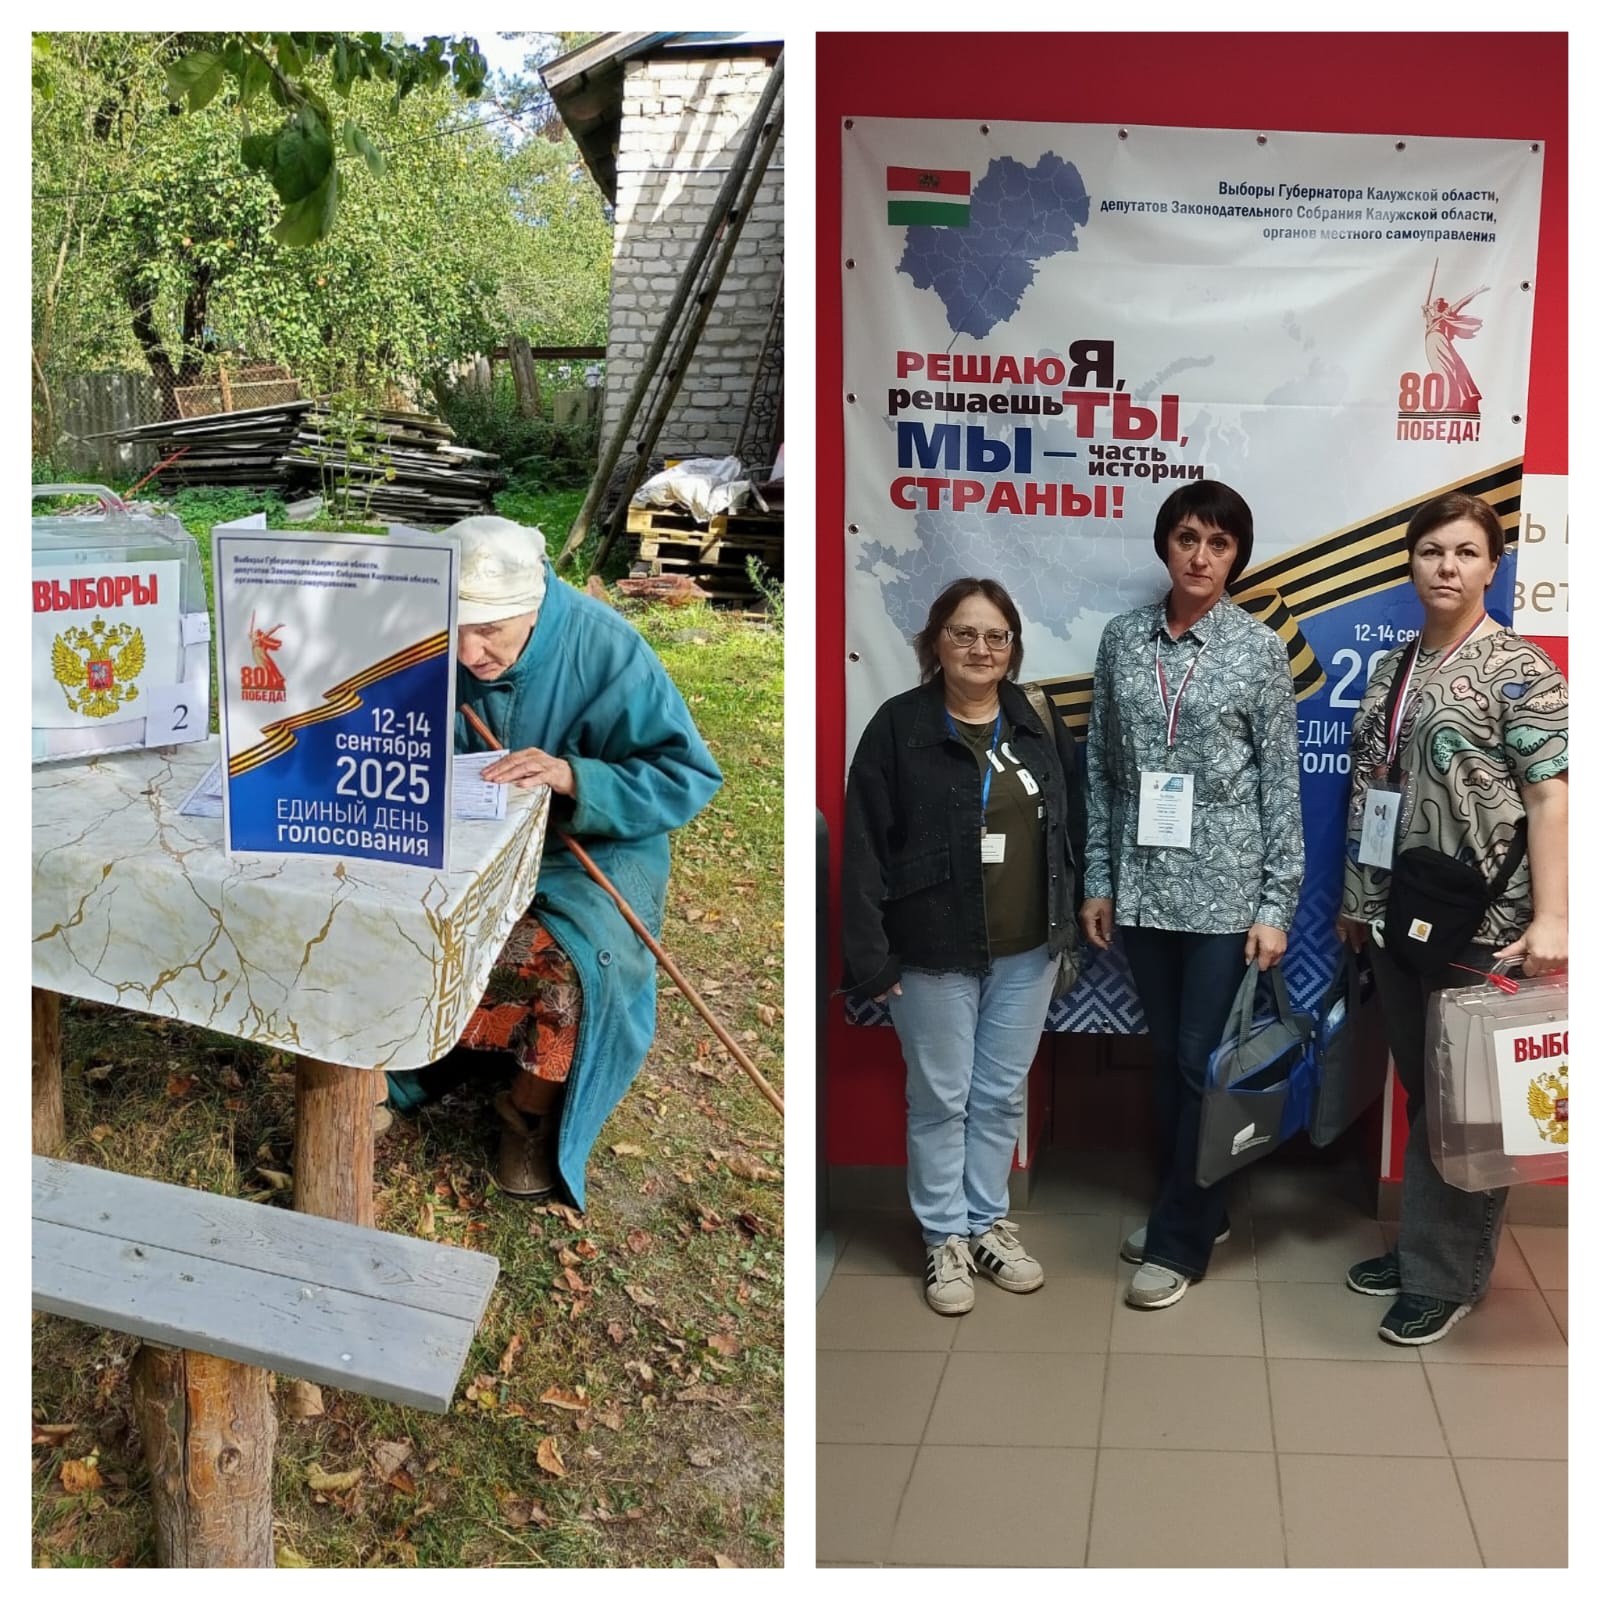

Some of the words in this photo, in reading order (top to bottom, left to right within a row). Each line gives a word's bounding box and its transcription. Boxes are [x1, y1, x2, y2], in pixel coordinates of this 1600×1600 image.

[1218, 181, 1275, 199] Выборы
[1278, 184, 1363, 202] Губернатора
[1366, 187, 1438, 203] Калужской
[1441, 188, 1499, 204] области,
[1100, 199, 1168, 214] депутатов
[1171, 200, 1293, 218] Законодательного
[1296, 205, 1362, 222] Собрания
[1366, 207, 1438, 223] Калужской
[1441, 207, 1497, 224] области,
[1263, 227, 1317, 241] органов
[1319, 229, 1382, 240] местного
[1385, 229, 1496, 243] самоуправления
[896, 350, 1066, 386] РЕШАЮ
[1067, 339, 1126, 393] Я,
[1398, 371, 1446, 412] 80
[888, 388, 1064, 416] решаешь
[1062, 390, 1189, 448] ТЫ,
[1396, 420, 1481, 445] ПОБЕДА!
[896, 421, 1032, 474] МЫ
[1088, 444, 1167, 462] часть
[1088, 460, 1205, 484] истории
[889, 476, 1126, 519] СТРАНЫ!
[1520, 513, 1546, 544] ь
[32, 574, 159, 612] ВЫБОРЫ
[1354, 624, 1395, 641] 12-14
[241, 666, 267, 689] 80
[241, 690, 287, 704] ПОБЕДА!
[171, 704, 189, 731] 2
[371, 707, 431, 738] 12-14
[335, 733, 431, 761] сентября
[1297, 720, 1352, 747] ЕДИН
[335, 755, 431, 805] 2025
[277, 798, 367, 826] ЕДИНЫЙ
[374, 807, 430, 834] ДЕНЬ
[277, 824, 430, 857] голосования
